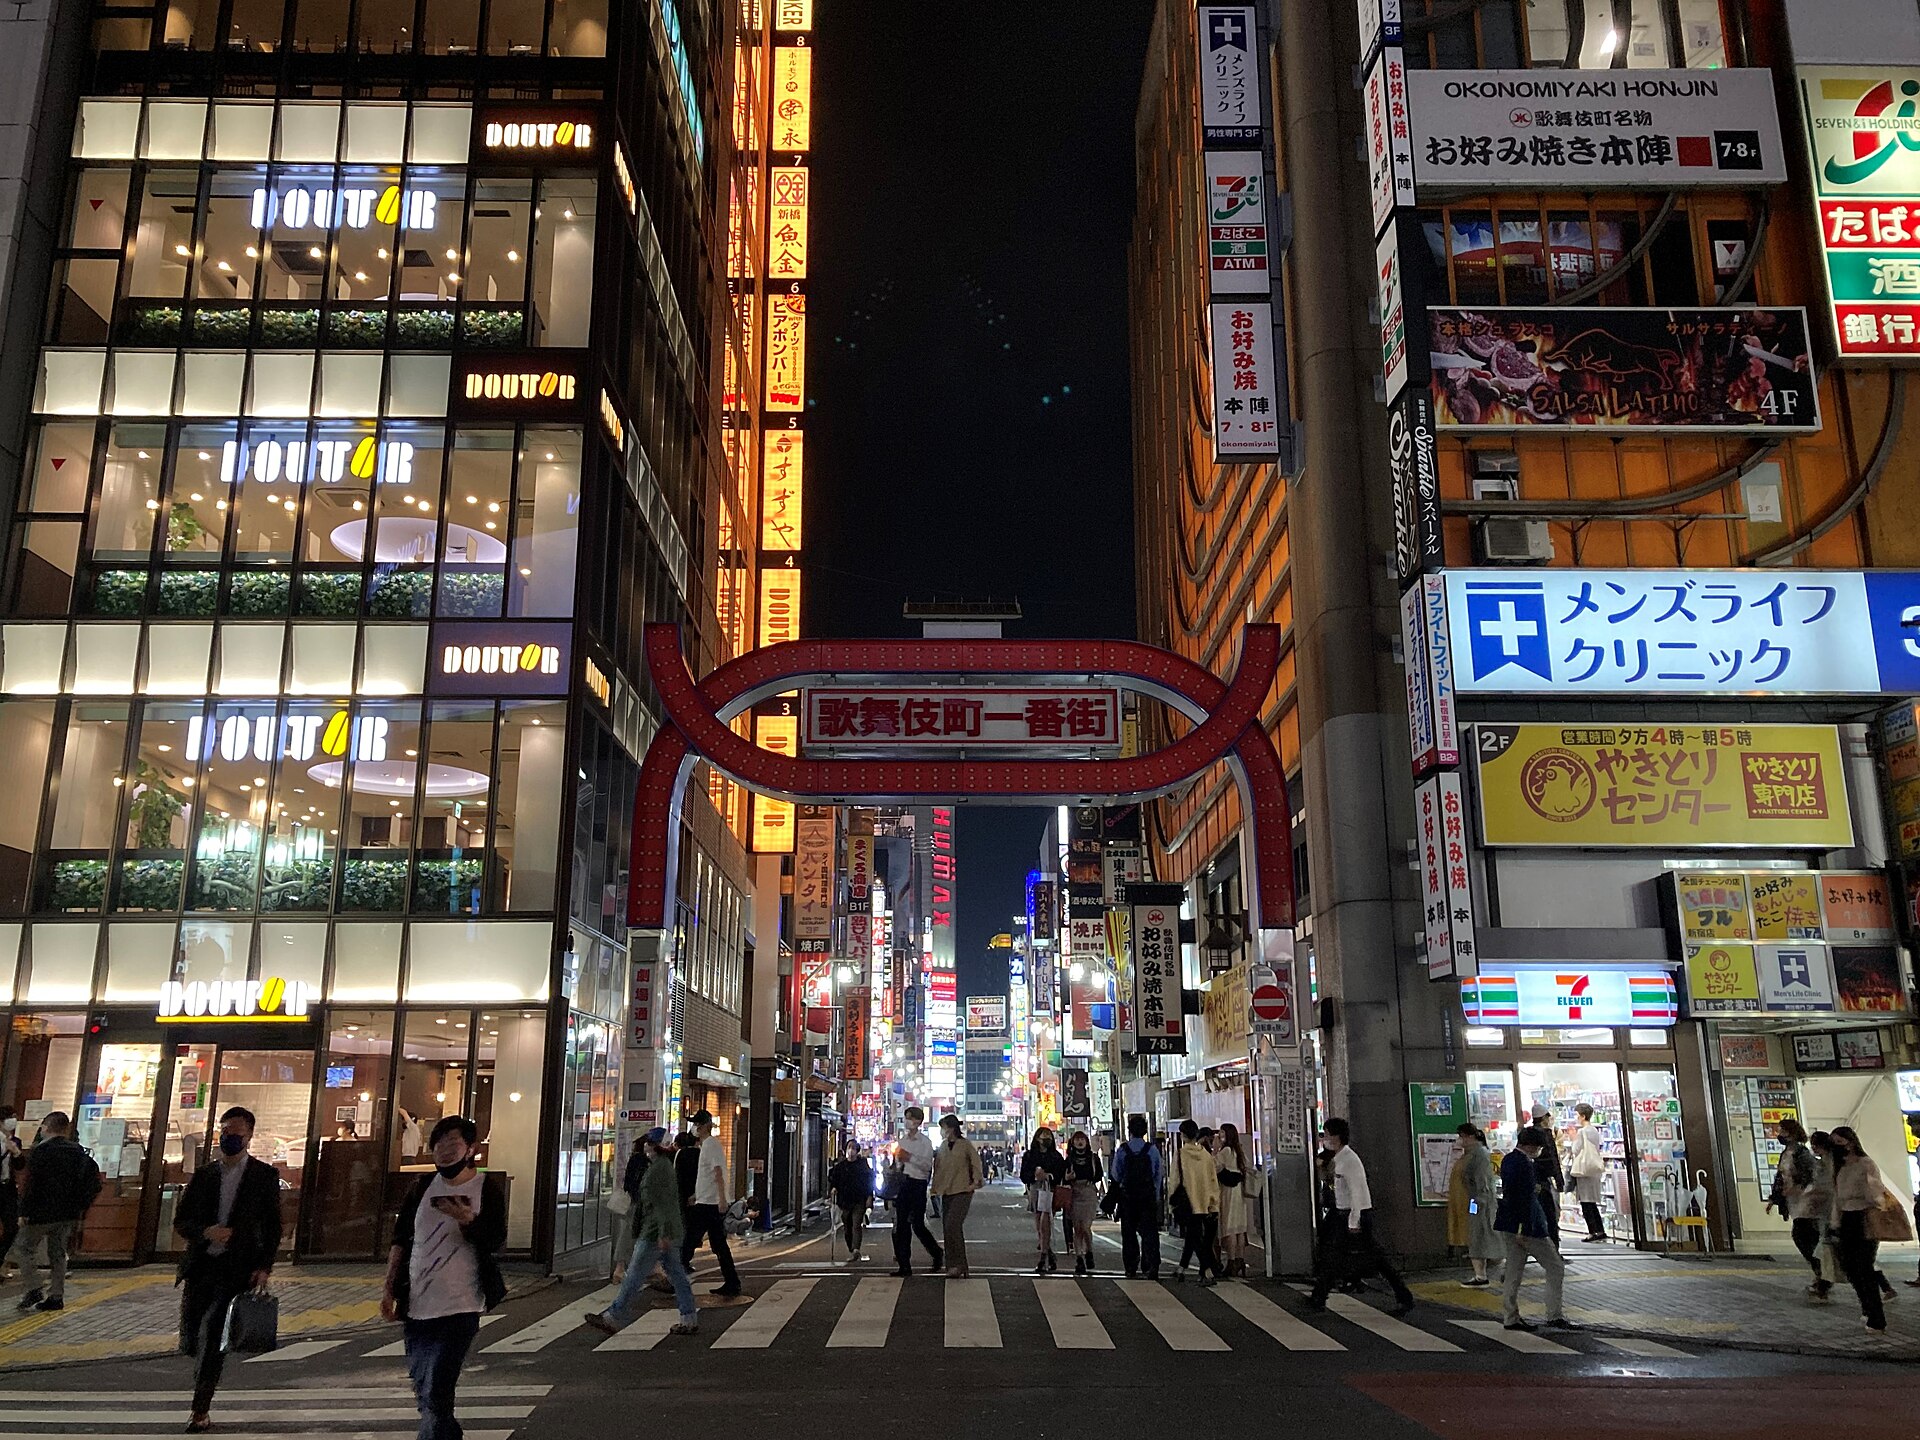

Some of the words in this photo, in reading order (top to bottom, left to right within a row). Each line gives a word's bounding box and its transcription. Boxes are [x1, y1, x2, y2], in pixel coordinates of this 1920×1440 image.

[783, 0, 804, 25] KER
[797, 36, 805, 46] 8
[1385, 27, 1400, 35] 3F
[1216, 53, 1230, 112] クリニック
[1232, 54, 1246, 124] メンズライフ
[1444, 81, 1615, 98] OKONOMIYAKI
[1624, 80, 1718, 97] HONJIN
[1389, 62, 1407, 138] お好み焼
[1535, 110, 1653, 127] 歌舞伎町名物
[486, 121, 591, 148] DOUTOR
[1207, 129, 1243, 137] 男性専門
[1245, 129, 1260, 137] 3F
[794, 155, 803, 167] 7
[1425, 136, 1672, 166] お好み焼き本陣
[1395, 152, 1412, 190] 本陣
[251, 185, 436, 229] DOUTOR
[779, 208, 801, 220] 新橋
[1219, 228, 1257, 239] たばこ
[773, 223, 804, 273] 魚金
[1230, 243, 1247, 254] 酒
[1223, 259, 1256, 269] ATM
[1868, 256, 1920, 295] 酒
[790, 282, 799, 293] 6
[772, 300, 789, 383] ビアポンバー
[790, 321, 800, 345] ダーツ
[1441, 321, 1554, 337] 本格シュラスコ
[1843, 313, 1920, 346] 銀行
[1231, 310, 1258, 391] お好み焼
[466, 371, 576, 399] DOUTOR
[1224, 397, 1270, 415] 本陣
[1530, 385, 1605, 416] SALSA
[1609, 386, 1700, 417] LATINO
[1761, 390, 1800, 415] 4F
[788, 417, 797, 429] 5
[1220, 440, 1277, 448] okonomiyaki
[220, 435, 412, 484] DOUTOR
[1414, 426, 1436, 500] Sparkle
[771, 456, 795, 548] すずや
[1390, 410, 1412, 578] Sparkle
[1422, 502, 1440, 556] スパークル
[785, 555, 794, 567] 4
[1560, 579, 1837, 627] メンズライフ
[1427, 592, 1451, 697] ファイトフィット
[443, 642, 560, 675] DOUTOR
[1563, 637, 1791, 684] クリニック
[1408, 618, 1425, 751] ファイトフィット
[782, 703, 791, 715] 3
[818, 697, 1108, 738] 歌舞伎町一番街
[186, 710, 388, 762] DOUTOR
[1440, 699, 1452, 748] 新宿東口駅前
[1564, 730, 1614, 744] 営業時間
[1481, 731, 1510, 751] 2F
[1440, 753, 1457, 762] B2F
[1595, 748, 1717, 787] やきとり
[1747, 756, 1817, 781] やきとり
[1601, 787, 1732, 826] センター
[1752, 783, 1817, 807] 専門店
[1422, 790, 1439, 895] お好み焼
[1445, 790, 1467, 889] お好み焼
[1753, 876, 1793, 899] お好み
[1755, 887, 1808, 914] もんじゃ
[849, 902, 870, 911] B1F
[1427, 899, 1446, 927] 本陣
[1756, 905, 1819, 929] たこ焼き
[1453, 907, 1473, 956] 本陣
[1688, 929, 1715, 938] 新宿店
[801, 940, 825, 952] 焼肉
[1163, 928, 1175, 977] 歌舞伎町名物
[1141, 926, 1164, 1029] お好み焼本陣
[1704, 972, 1739, 984] やきとり
[1706, 983, 1743, 995] センター
[158, 976, 308, 1018] DOUTOR
[634, 968, 651, 1041] 劇場通り
[1557, 997, 1593, 1006] ELEVEN
[1696, 1000, 1757, 1011] 朝まで営業中
[1633, 1100, 1660, 1113] たばこ
[1666, 1101, 1679, 1113] 酒
